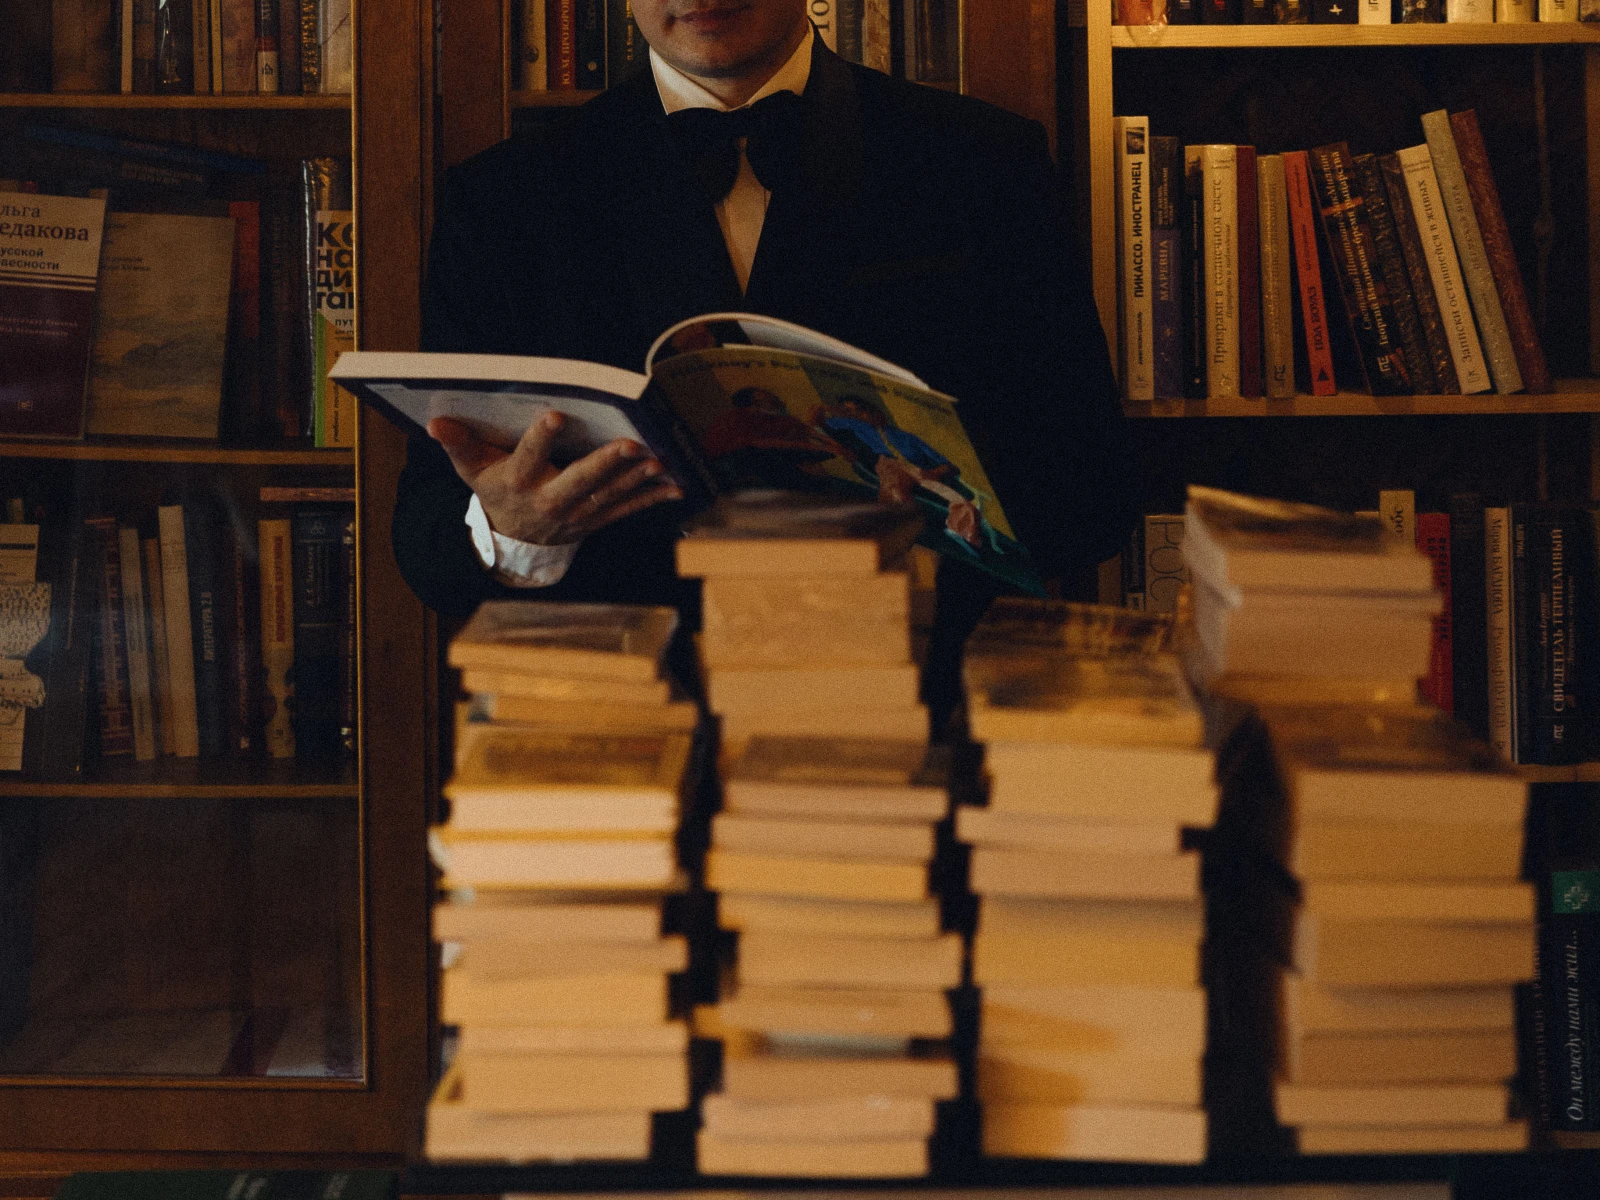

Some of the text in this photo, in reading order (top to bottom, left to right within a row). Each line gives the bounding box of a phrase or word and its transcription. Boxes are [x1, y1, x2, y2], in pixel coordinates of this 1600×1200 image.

[561, 56, 571, 69] М.
[561, 72, 571, 85] Ю.
[1132, 162, 1142, 237] ИНОСТРАНЕЦ
[1212, 179, 1221, 214] свете
[1418, 180, 1436, 224] живых
[1133, 240, 1144, 298] ПИКАССО.
[1159, 240, 1169, 301] МАРЕВНА
[1213, 217, 1222, 286] солнечном
[1437, 238, 1459, 312] оставшейся
[1213, 302, 1226, 364] Призраки
[1455, 314, 1473, 363] Записки
[1491, 519, 1502, 553] Мария
[1491, 556, 1502, 615] БАГАНОВА
[1550, 528, 1565, 713] СВИДЕТЕЛЬ ТЕРПЕЛИВЫЙ
[1564, 927, 1584, 1121] Он между нами жил...
